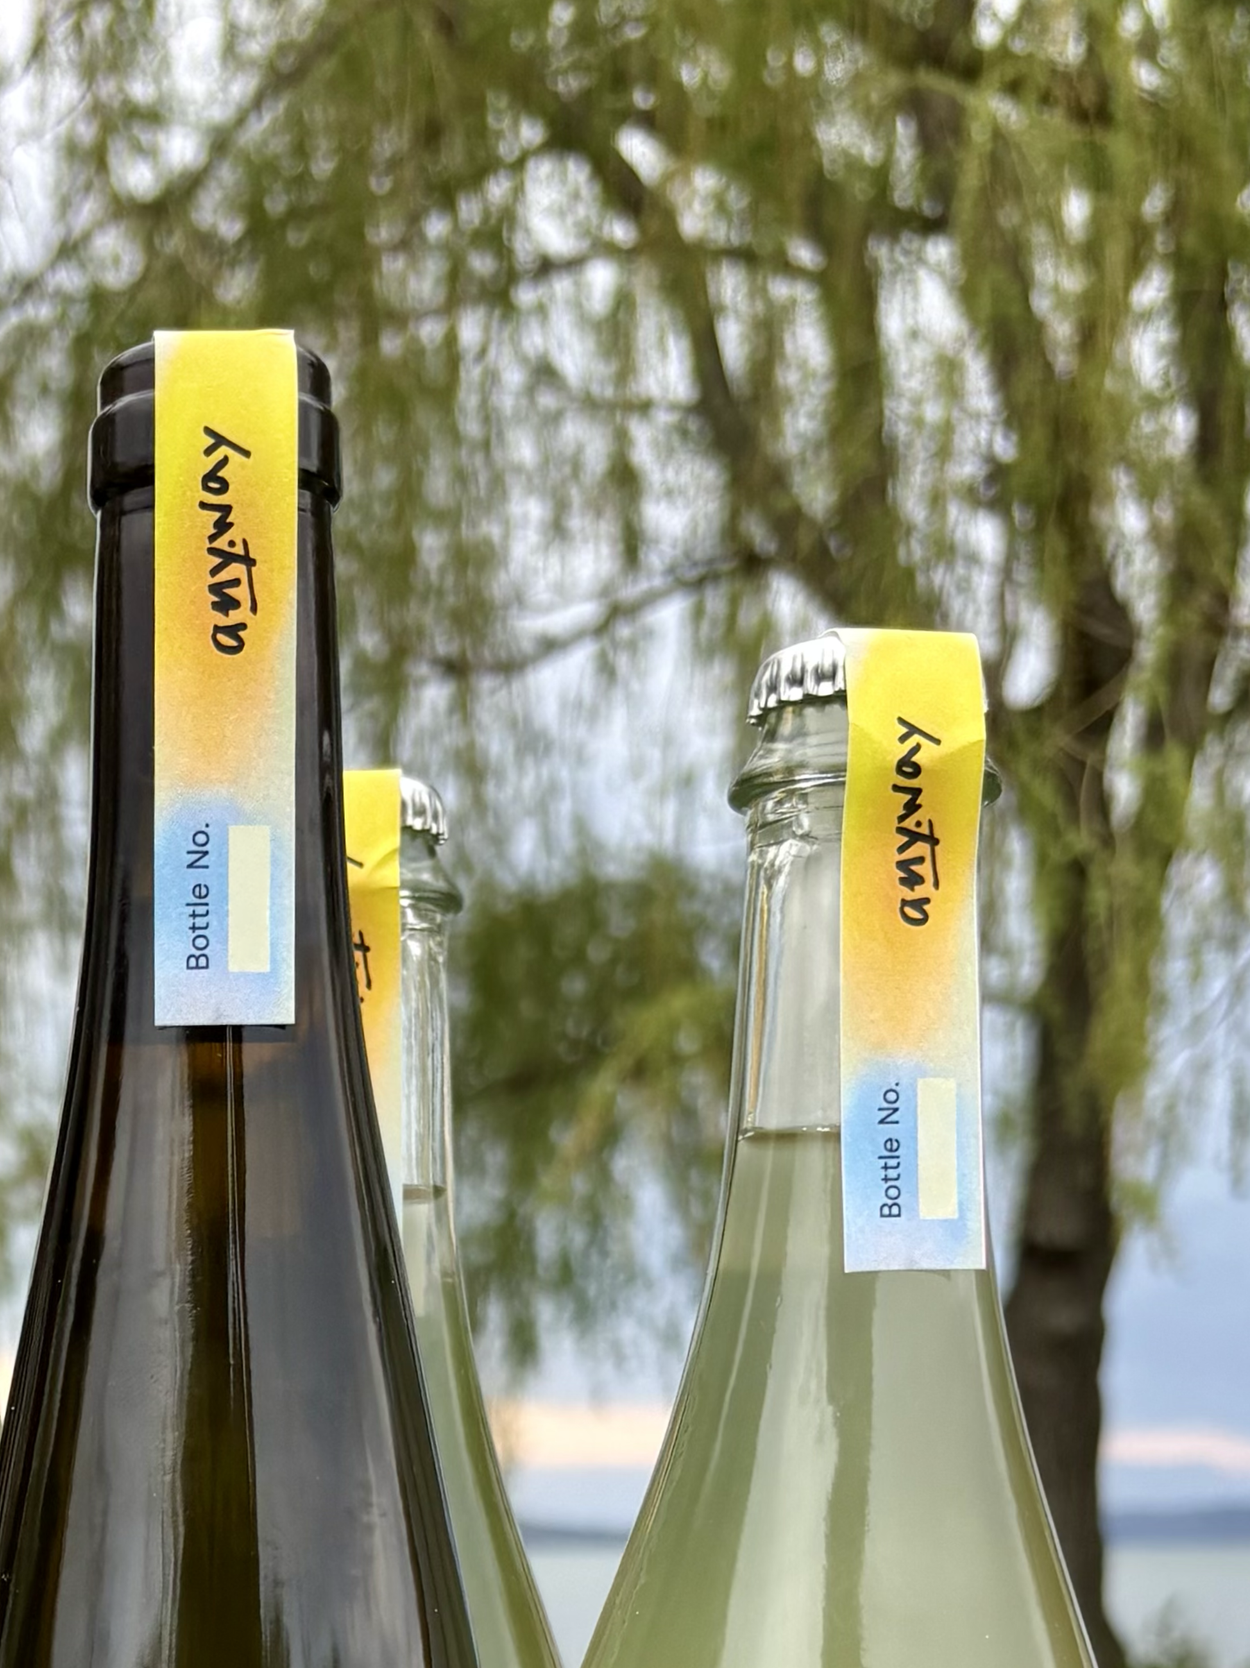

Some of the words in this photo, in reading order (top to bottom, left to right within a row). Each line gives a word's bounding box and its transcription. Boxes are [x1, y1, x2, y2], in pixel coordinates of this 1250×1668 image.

[186, 823, 210, 870] No.
[185, 883, 210, 970] Bottle
[877, 1082, 900, 1125] No.
[877, 1137, 902, 1218] Bottle
